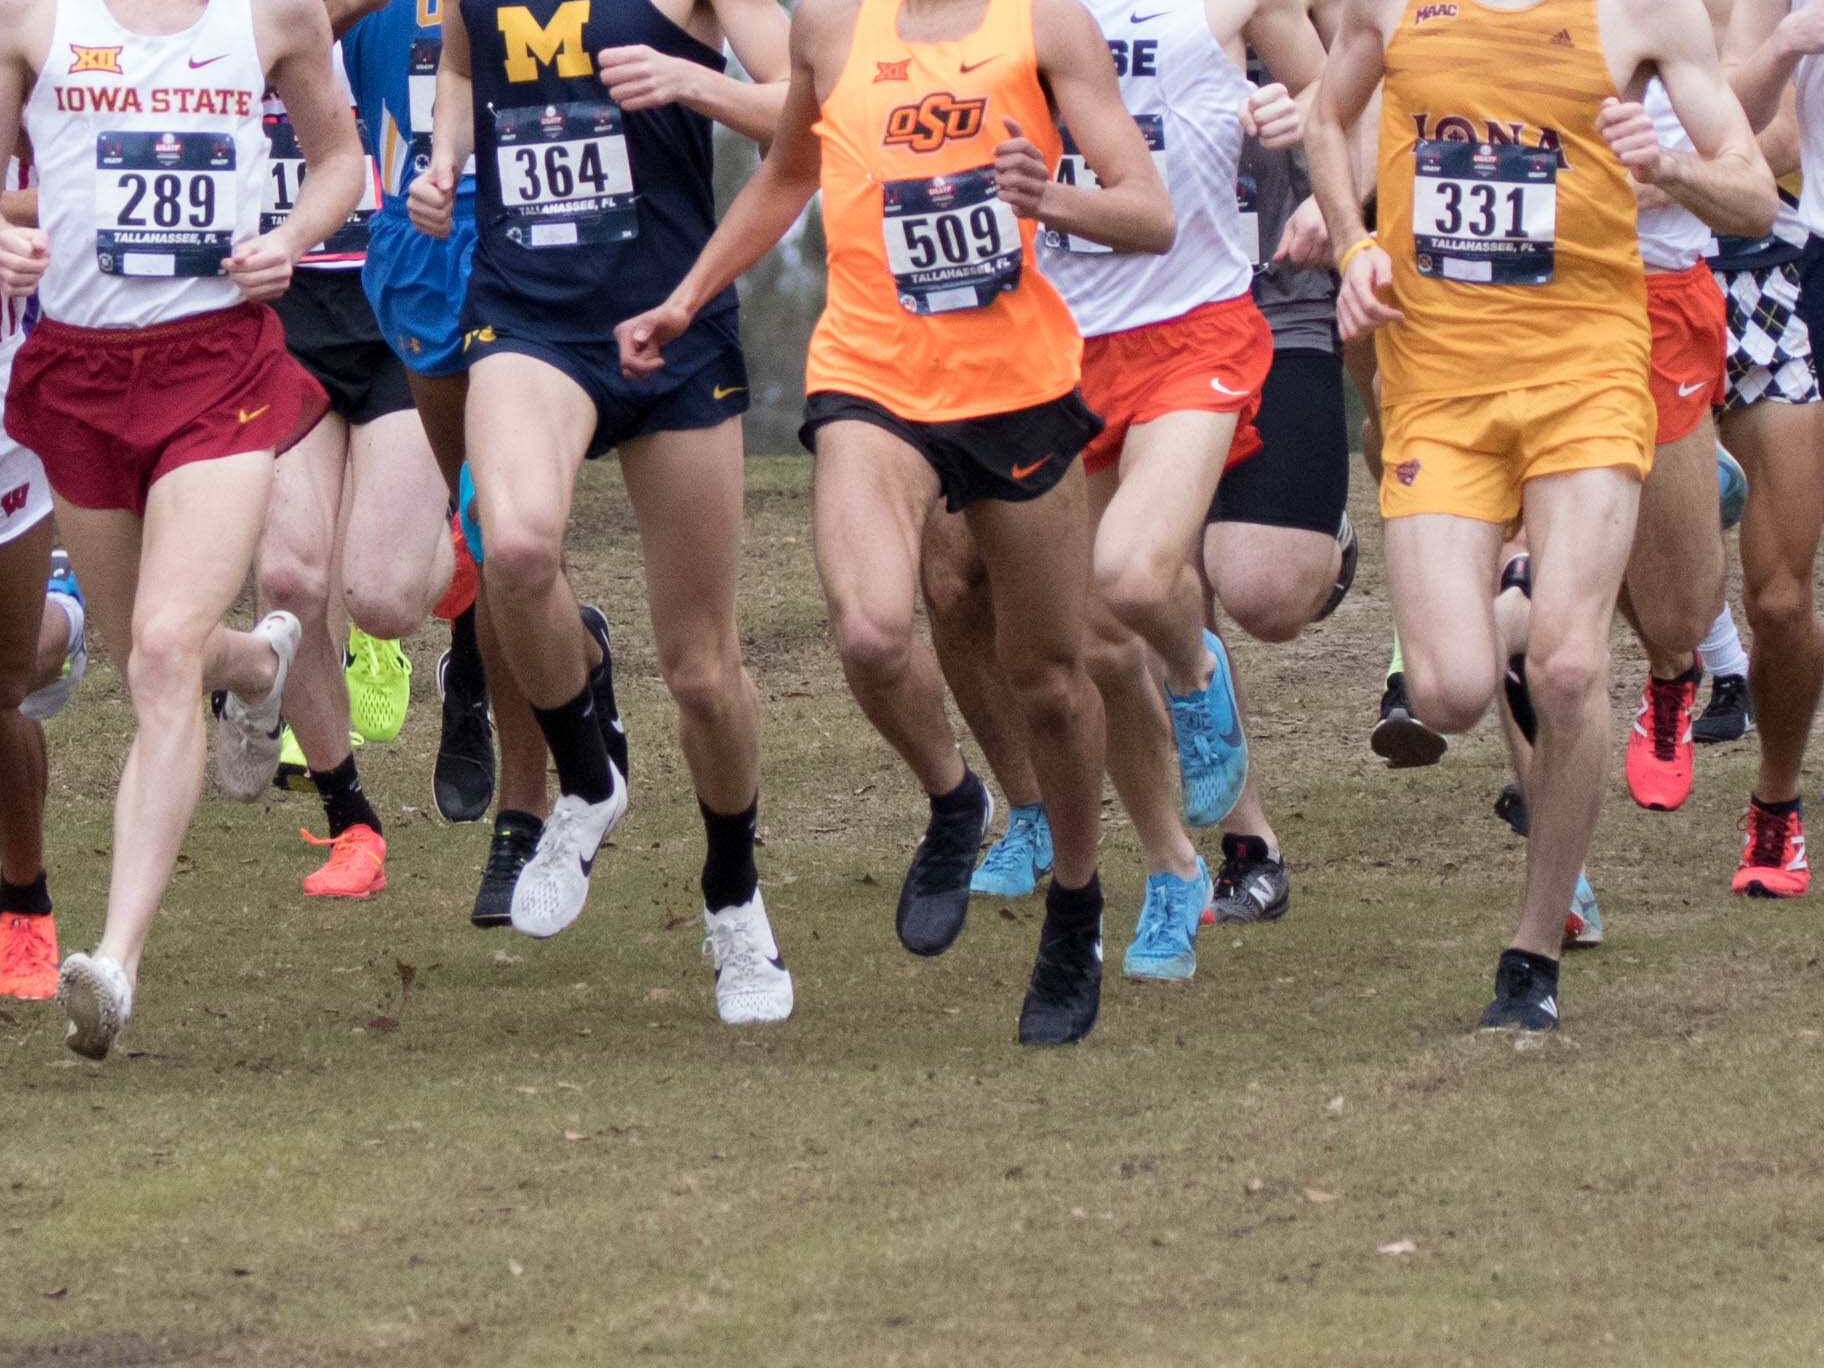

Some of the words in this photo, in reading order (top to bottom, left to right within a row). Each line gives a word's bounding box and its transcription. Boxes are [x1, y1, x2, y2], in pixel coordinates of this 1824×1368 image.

[497, 0, 594, 83] M
[1415, 4, 1458, 25] MAAC
[54, 86, 143, 113] IOWA
[151, 89, 252, 117] STATE
[882, 91, 988, 155] OSU
[1411, 112, 1573, 170] IONA
[515, 141, 609, 201] 364
[117, 173, 215, 228] 289
[519, 201, 598, 216] TALLAHASSEE,
[601, 199, 616, 209] FL
[1435, 182, 1528, 238] 331
[113, 232, 201, 245] TALLAHASSEE,
[204, 233, 217, 244] FL
[902, 205, 1002, 269] 509
[1431, 238, 1517, 253] TALLAHASSEE,
[1520, 243, 1536, 252] FL
[911, 261, 996, 284] TALLAHASSEE,
[997, 257, 1011, 269] FL
